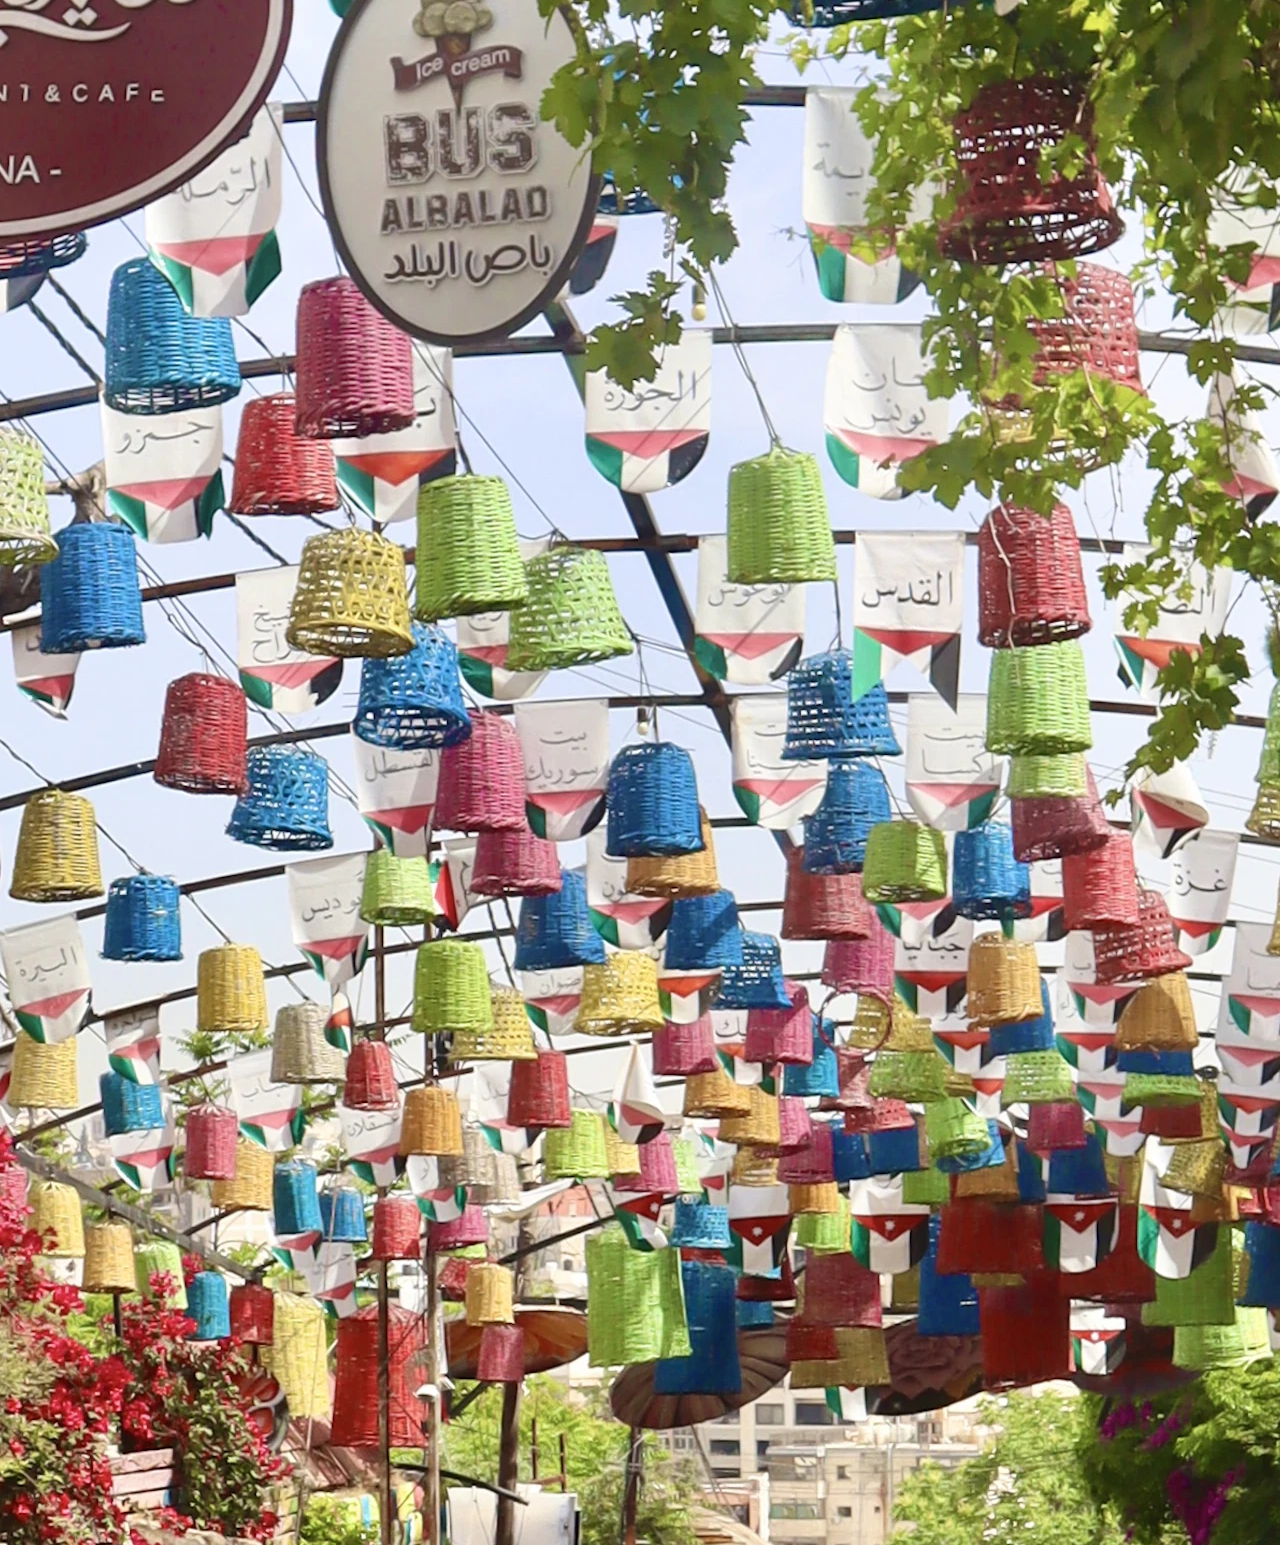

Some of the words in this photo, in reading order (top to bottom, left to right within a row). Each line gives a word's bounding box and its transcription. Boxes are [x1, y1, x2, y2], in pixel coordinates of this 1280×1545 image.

[416, 56, 444, 78] Ice
[450, 47, 511, 76] cream
[383, 101, 538, 187] BUS
[380, 186, 551, 235] ALBALAD
[384, 240, 456, 287] البلد
[465, 234, 551, 284] باص
[861, 571, 954, 608] القدس
[1173, 862, 1228, 897] غزة
